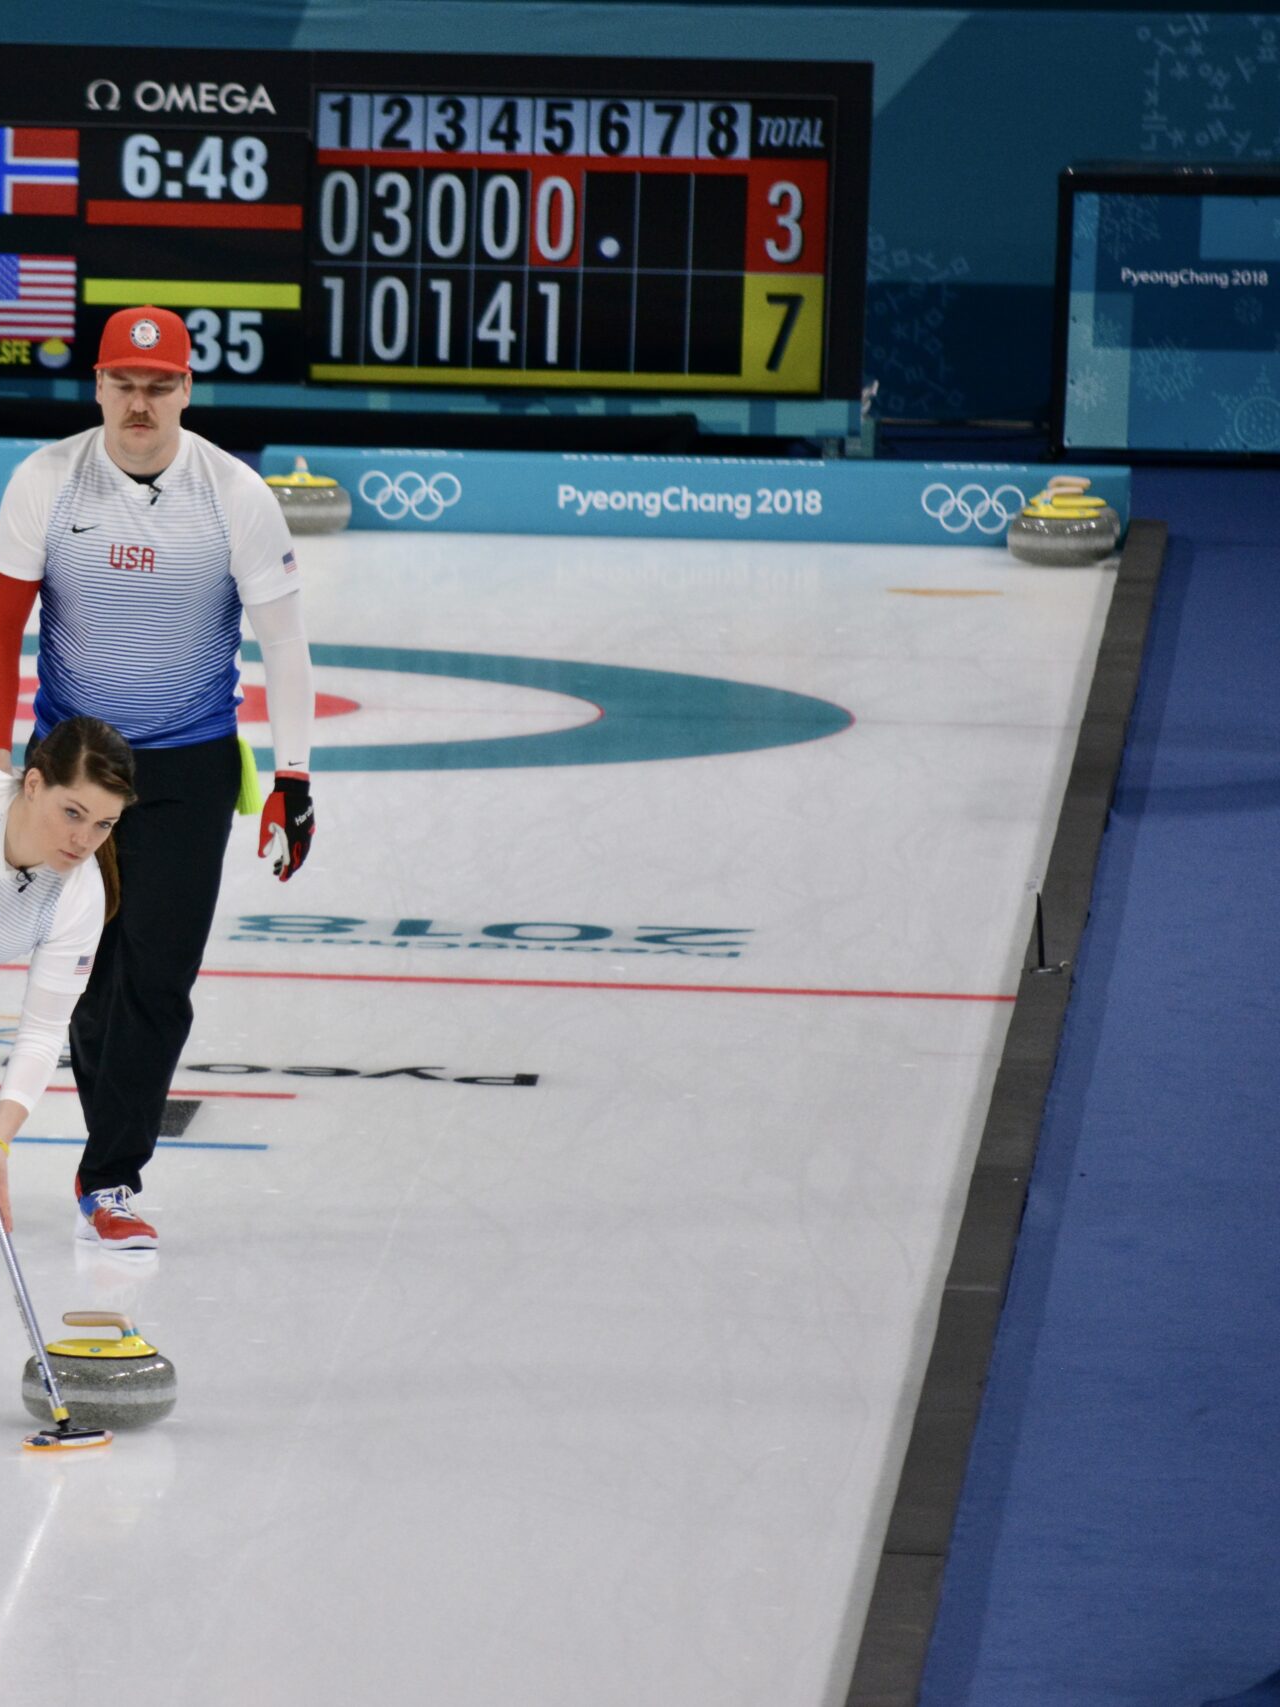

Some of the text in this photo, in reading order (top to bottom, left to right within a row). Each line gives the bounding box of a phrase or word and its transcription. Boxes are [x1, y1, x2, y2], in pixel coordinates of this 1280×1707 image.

[134, 81, 277, 114] OMEGA
[330, 97, 825, 158] 1 2 3 4 5 6 7 8 TOTAL
[122, 133, 269, 201] 6:48
[320, 171, 804, 264] 0 3 0 0 0 3
[1120, 266, 1269, 288] PyeongChang 2018
[323, 276, 805, 373] 1 0 1 4 1 7
[557, 484, 823, 518] PyeongChang 2018
[108, 543, 155, 574] USA
[227, 914, 756, 947] 2018
